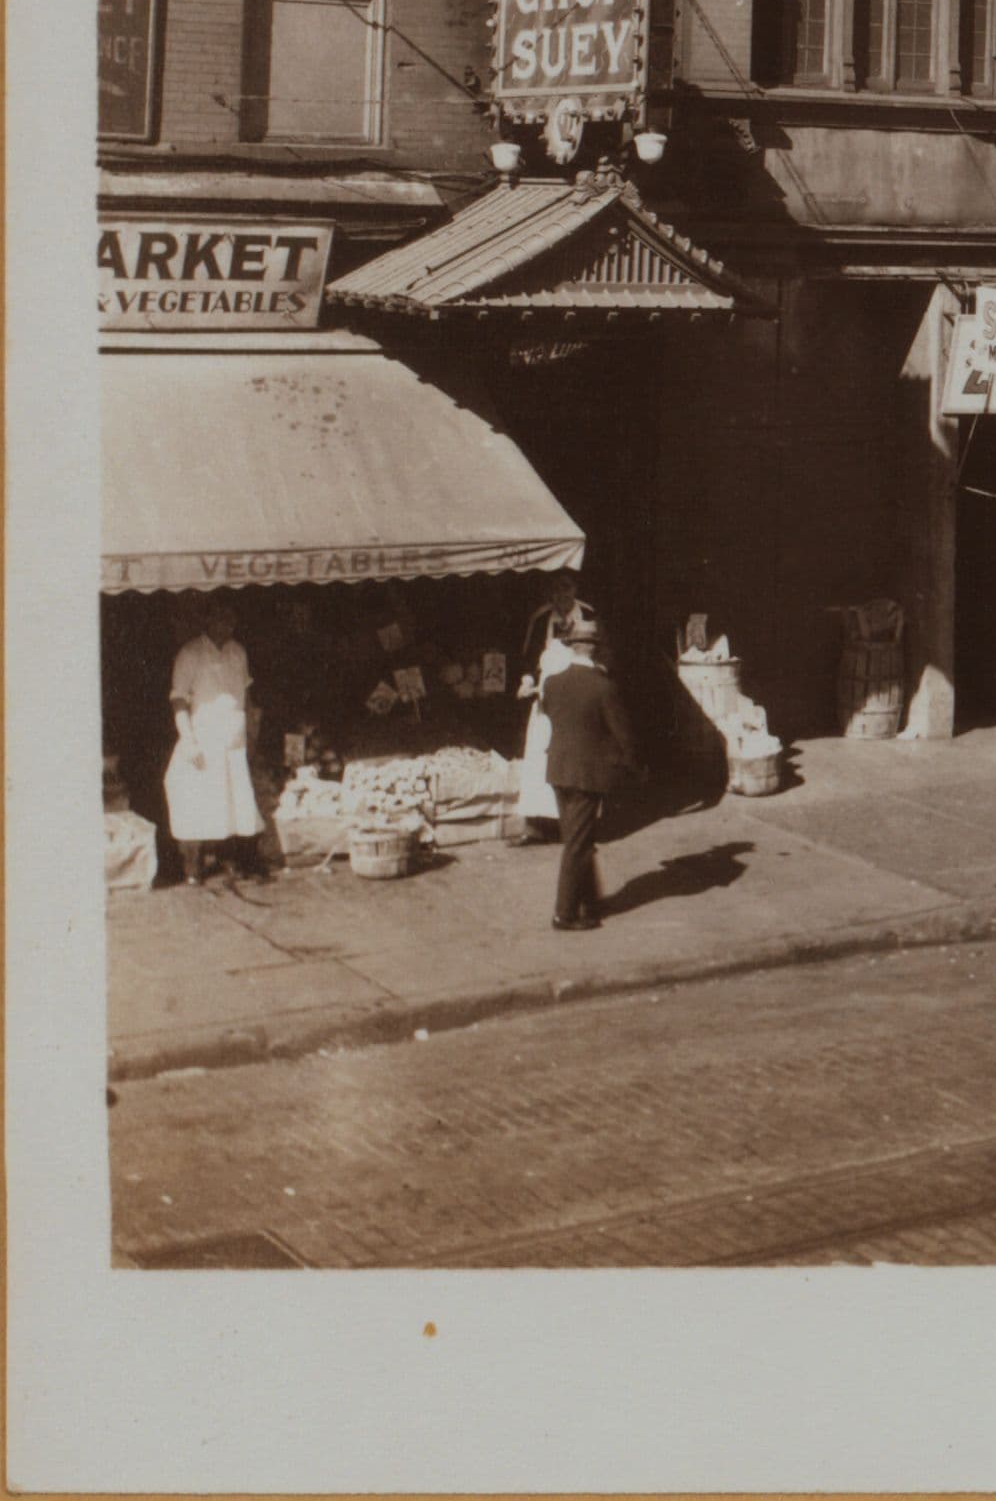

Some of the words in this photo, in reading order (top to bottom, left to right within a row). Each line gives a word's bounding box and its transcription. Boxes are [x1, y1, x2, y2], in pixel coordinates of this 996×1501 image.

[511, 19, 632, 80] SUEY
[97, 230, 319, 281] ARKET
[116, 289, 307, 314] VEGETABLES
[199, 549, 451, 582] VEGETABLES
